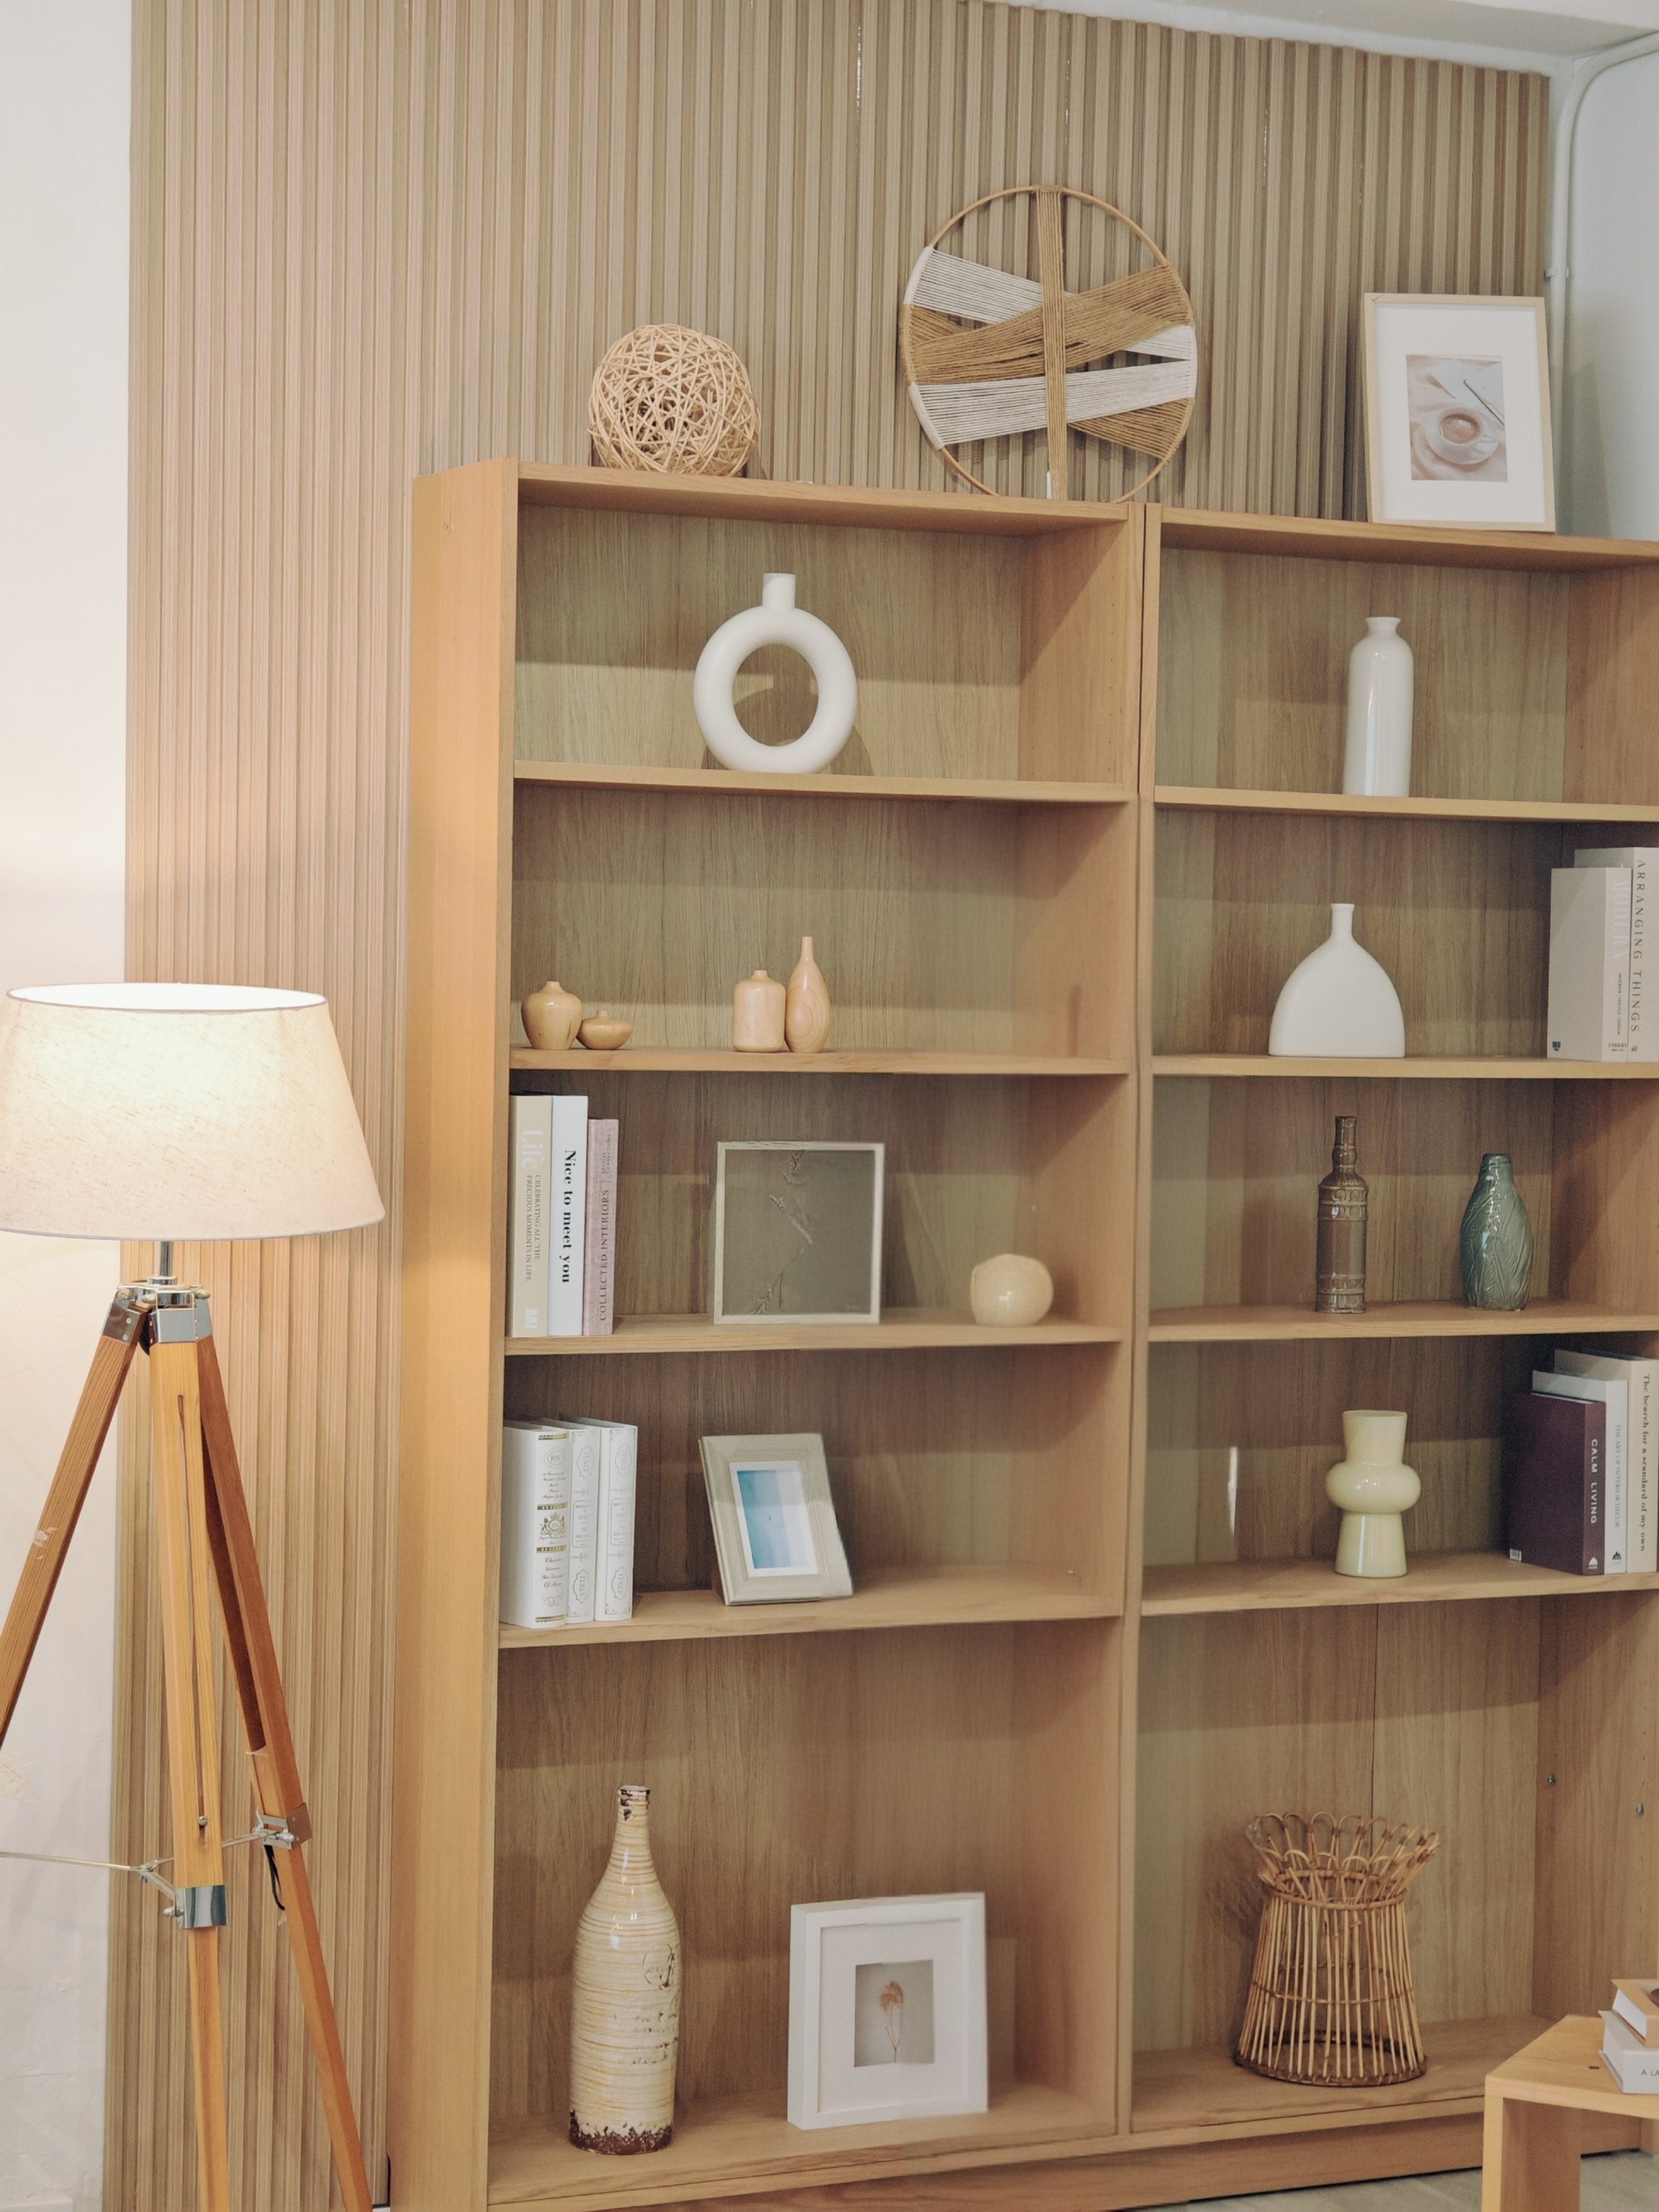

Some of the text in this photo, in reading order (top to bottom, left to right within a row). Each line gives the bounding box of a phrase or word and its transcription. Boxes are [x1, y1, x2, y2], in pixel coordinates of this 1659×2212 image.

[1630, 860, 1646, 1032] ARRANGING THINGS
[559, 1150, 576, 1283] Nice to meet you
[525, 1255, 531, 1263] IN
[599, 1190, 609, 1321] COLLECTED INTERIORS
[1640, 1515, 1645, 1528] my
[1641, 1502, 1647, 1512] of
